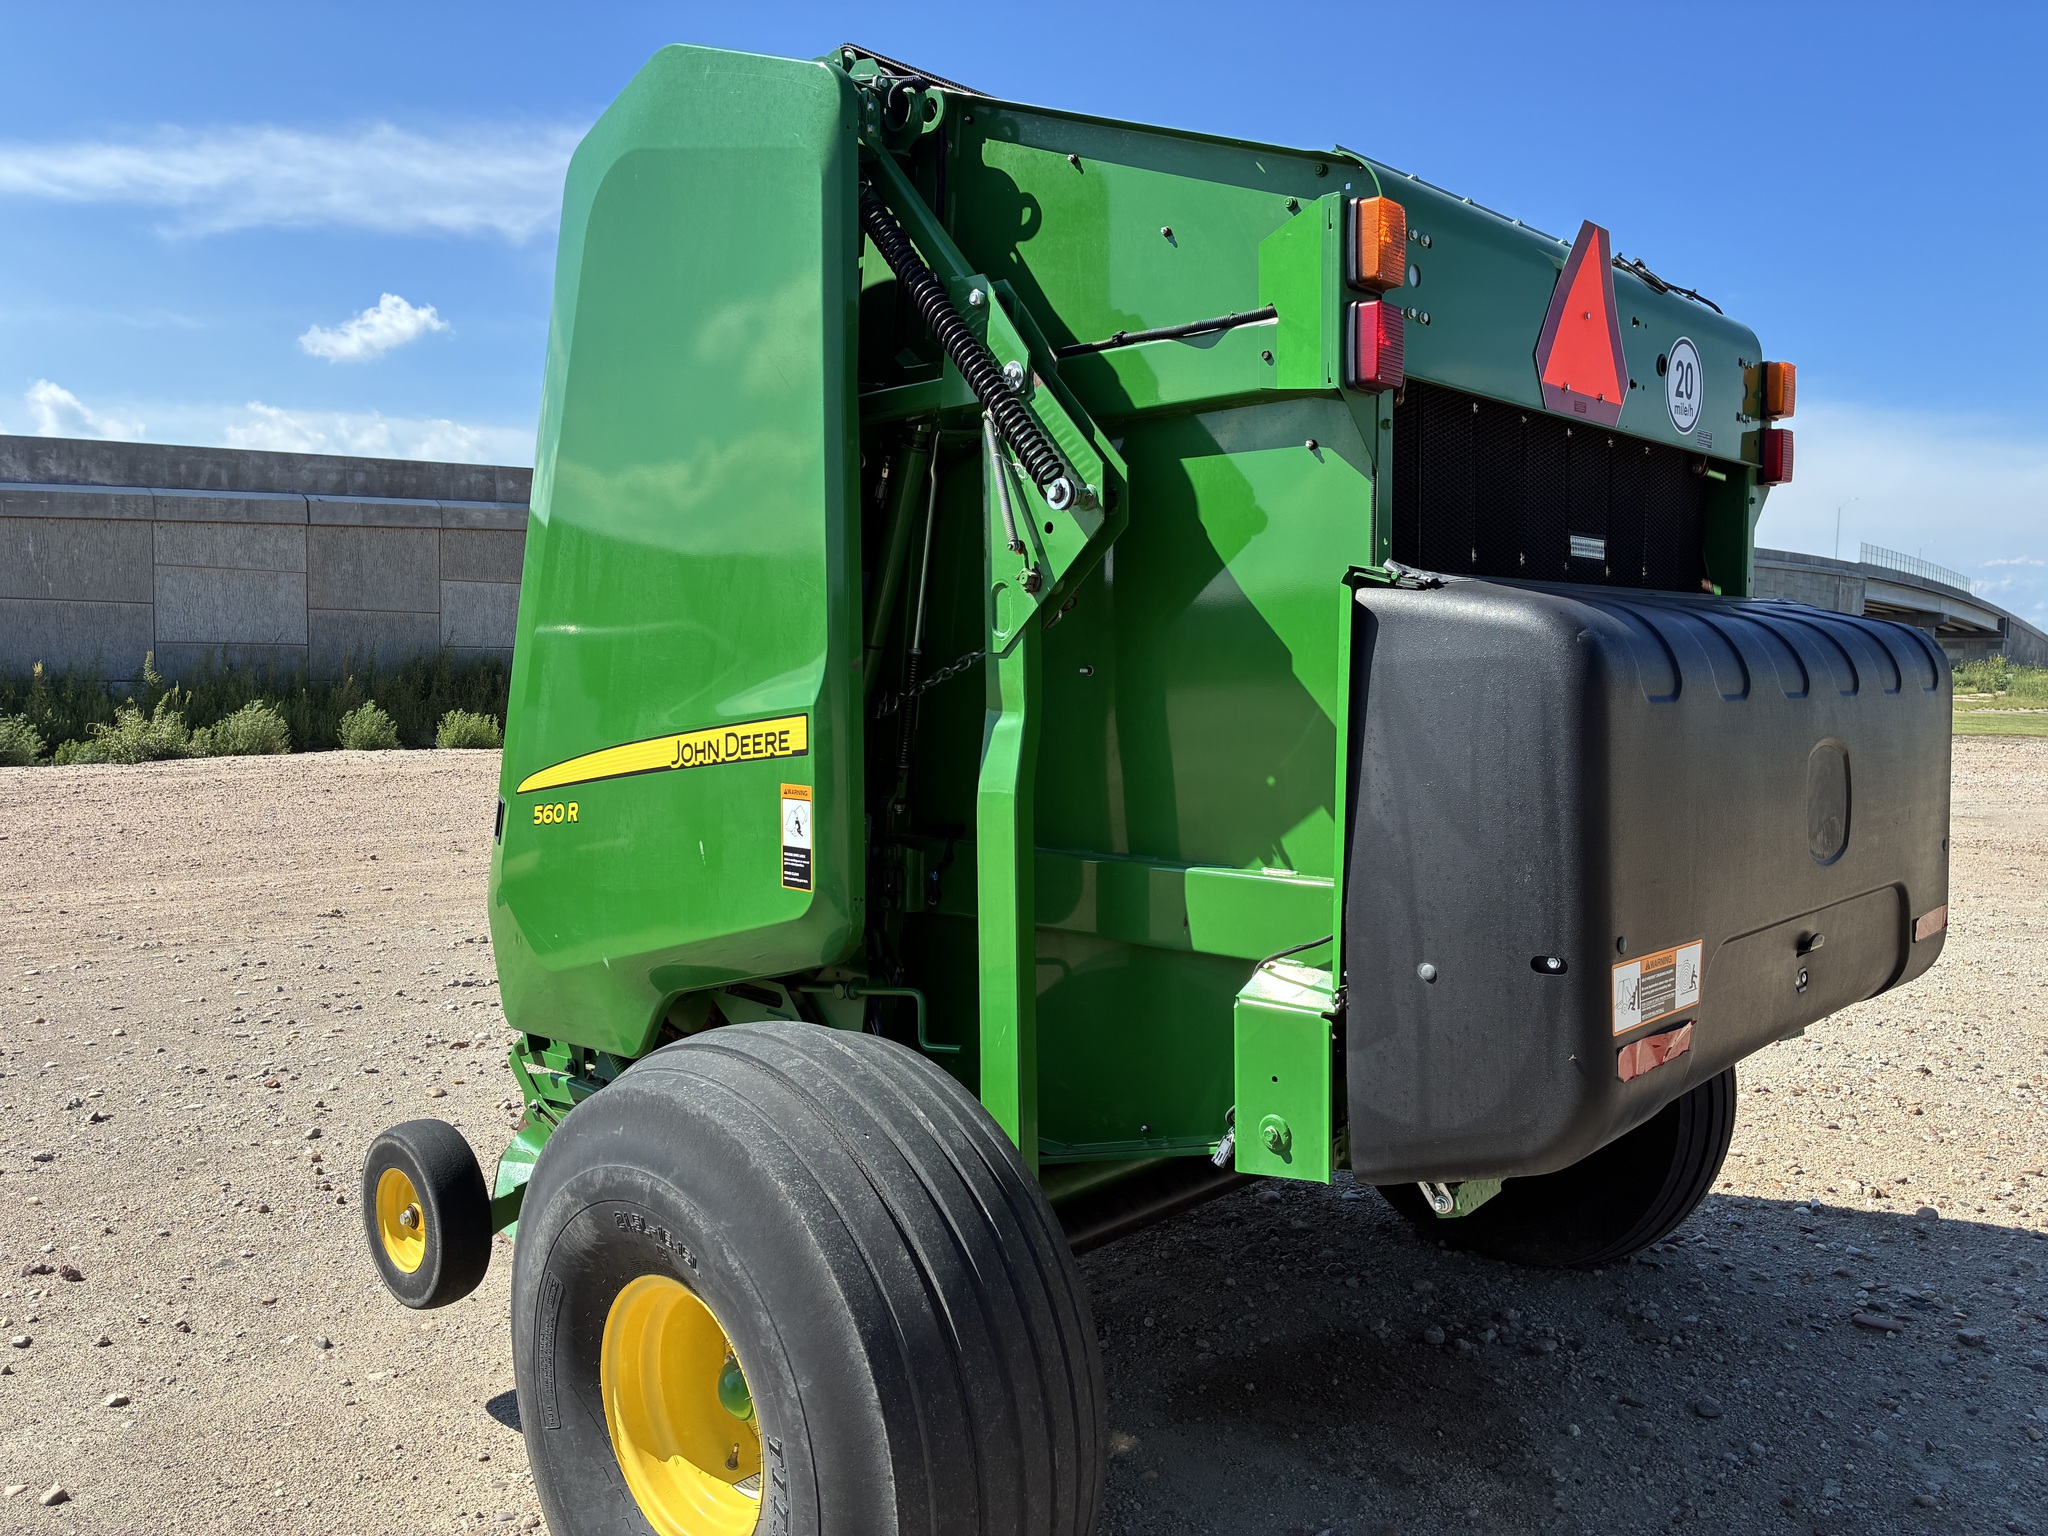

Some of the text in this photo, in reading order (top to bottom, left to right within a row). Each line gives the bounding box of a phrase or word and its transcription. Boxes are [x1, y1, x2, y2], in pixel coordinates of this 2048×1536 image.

[1675, 360, 1694, 400] 20
[1674, 403, 1694, 417] mile/h
[671, 730, 790, 765] JOHN DEERE
[787, 789, 808, 797] WARNING
[533, 801, 579, 825] 560 R
[1650, 955, 1672, 969] WARNING
